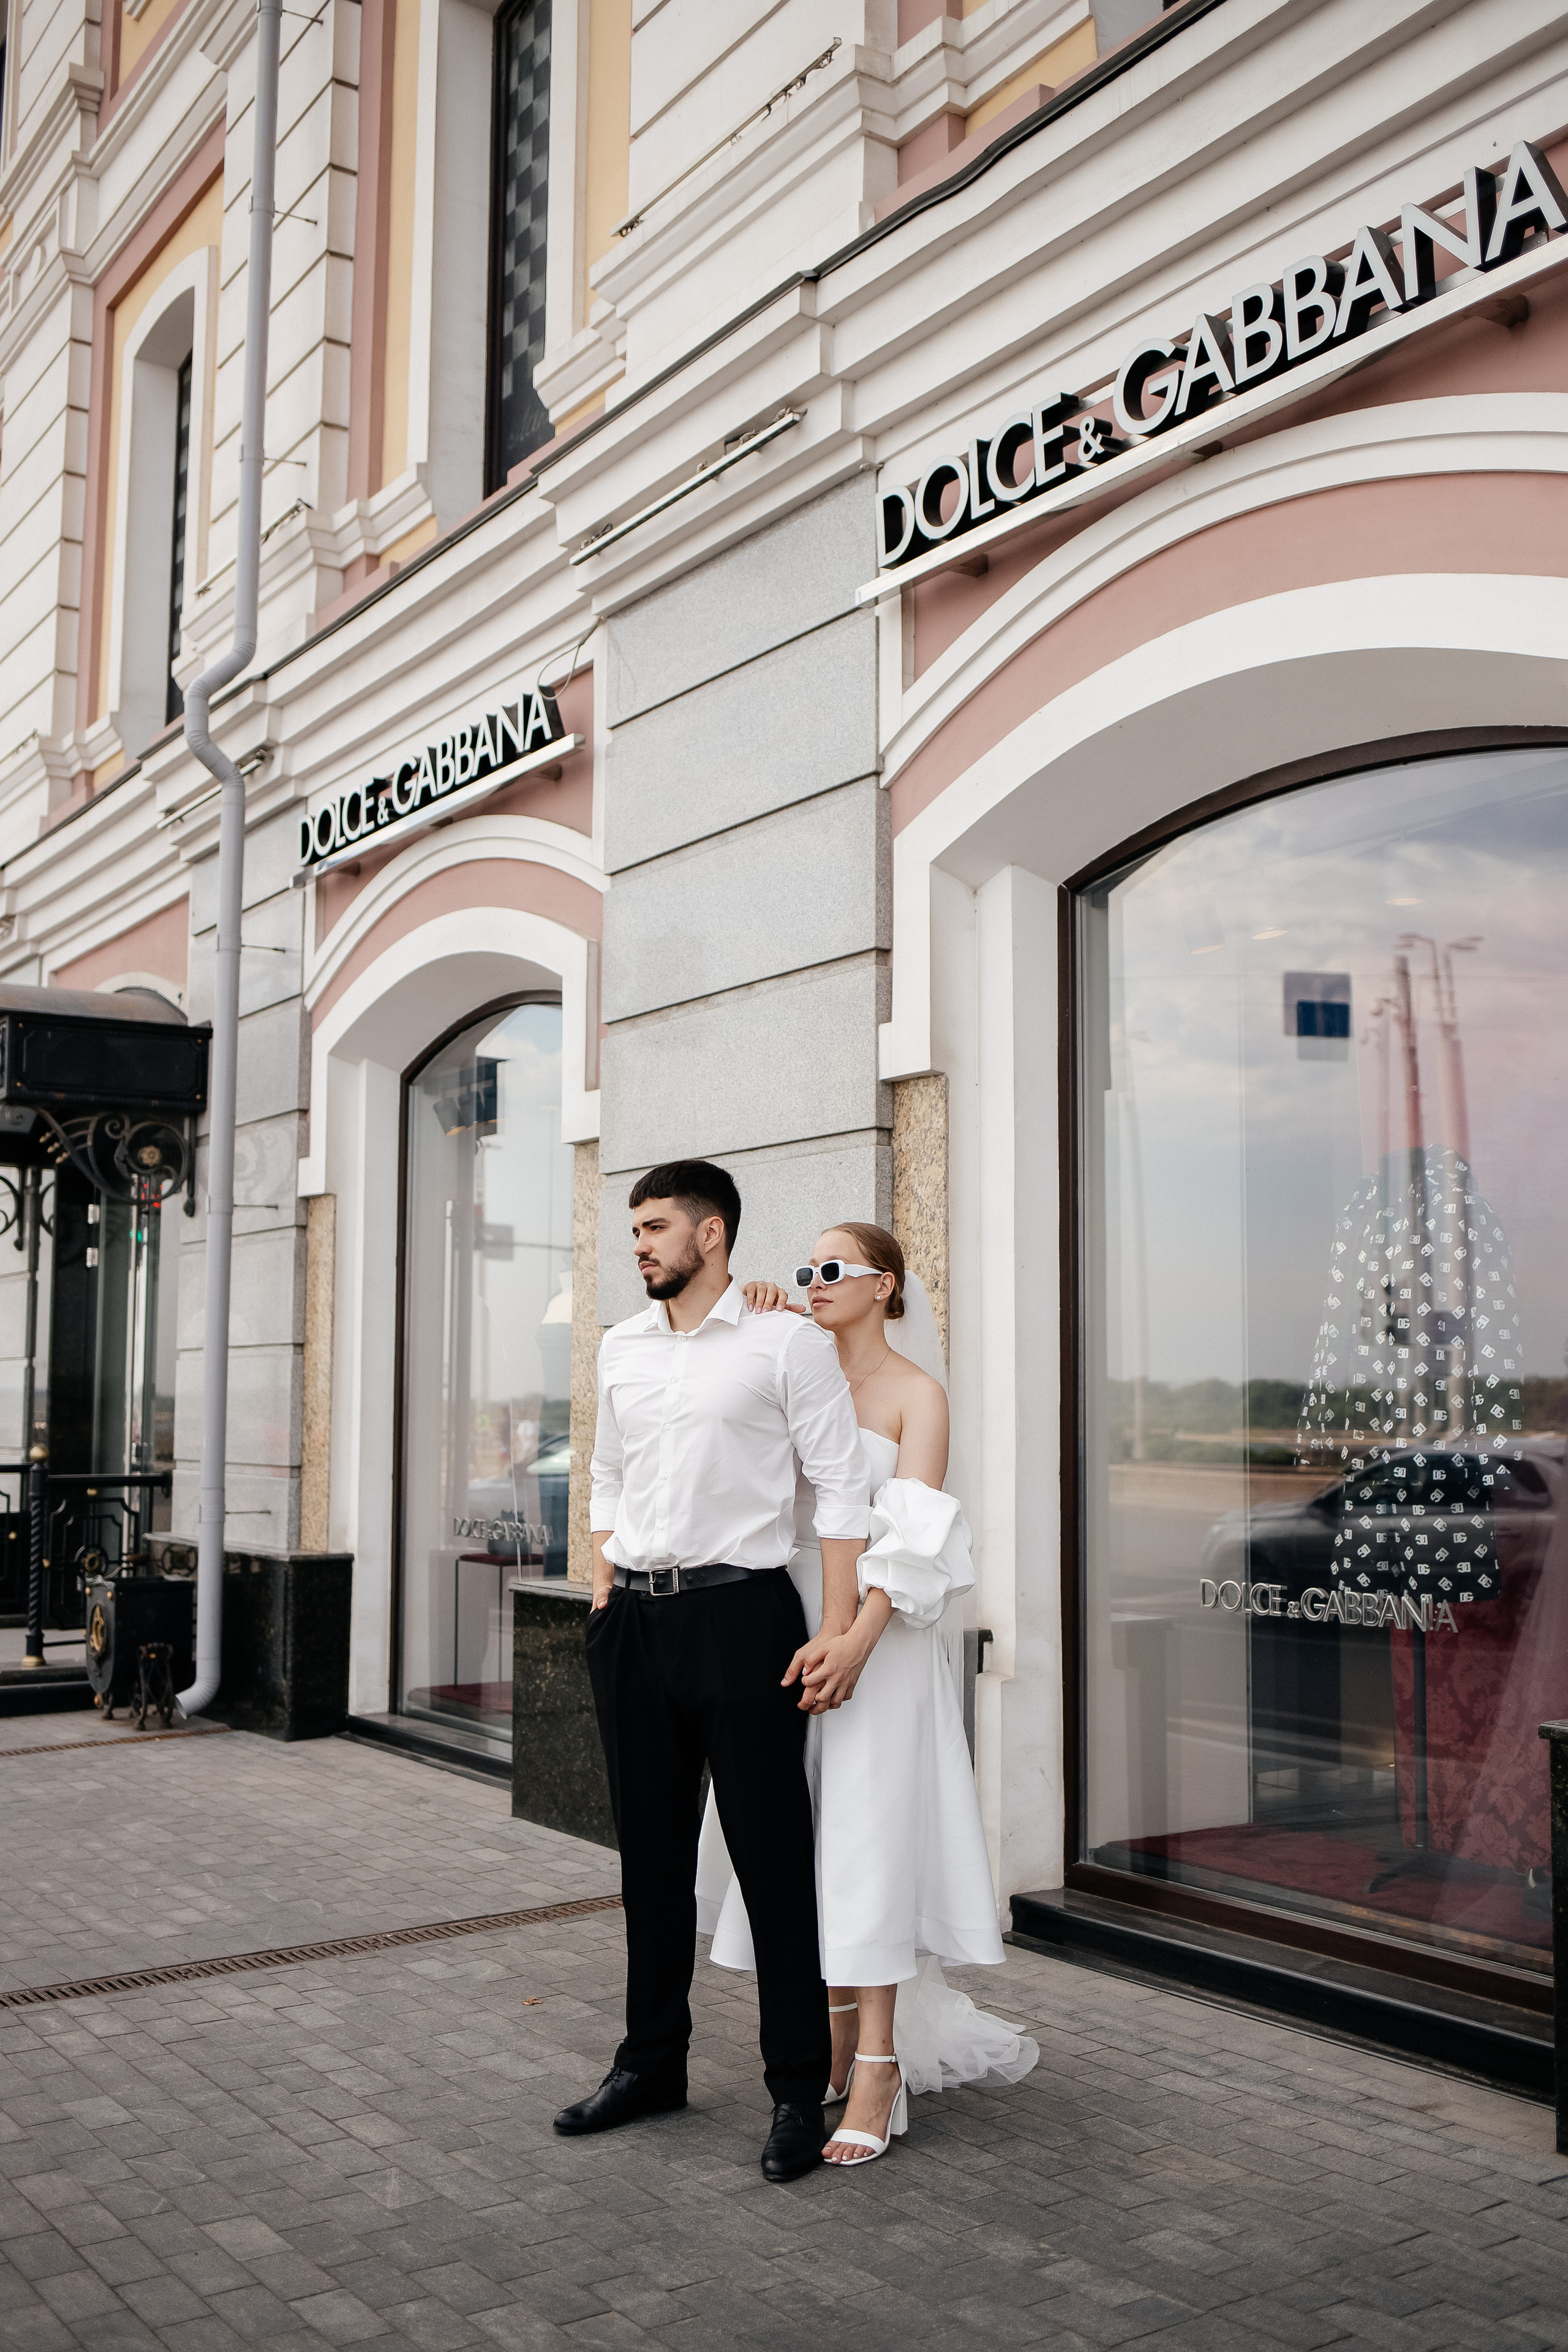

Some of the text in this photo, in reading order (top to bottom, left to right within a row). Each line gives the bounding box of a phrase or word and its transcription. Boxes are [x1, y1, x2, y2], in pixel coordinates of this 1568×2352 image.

[876, 140, 1567, 568] DOLCE & GABBANA
[299, 690, 552, 866] DOLCE & GABBANA
[1200, 1578, 1458, 1632] DOLCE & GABBANA
